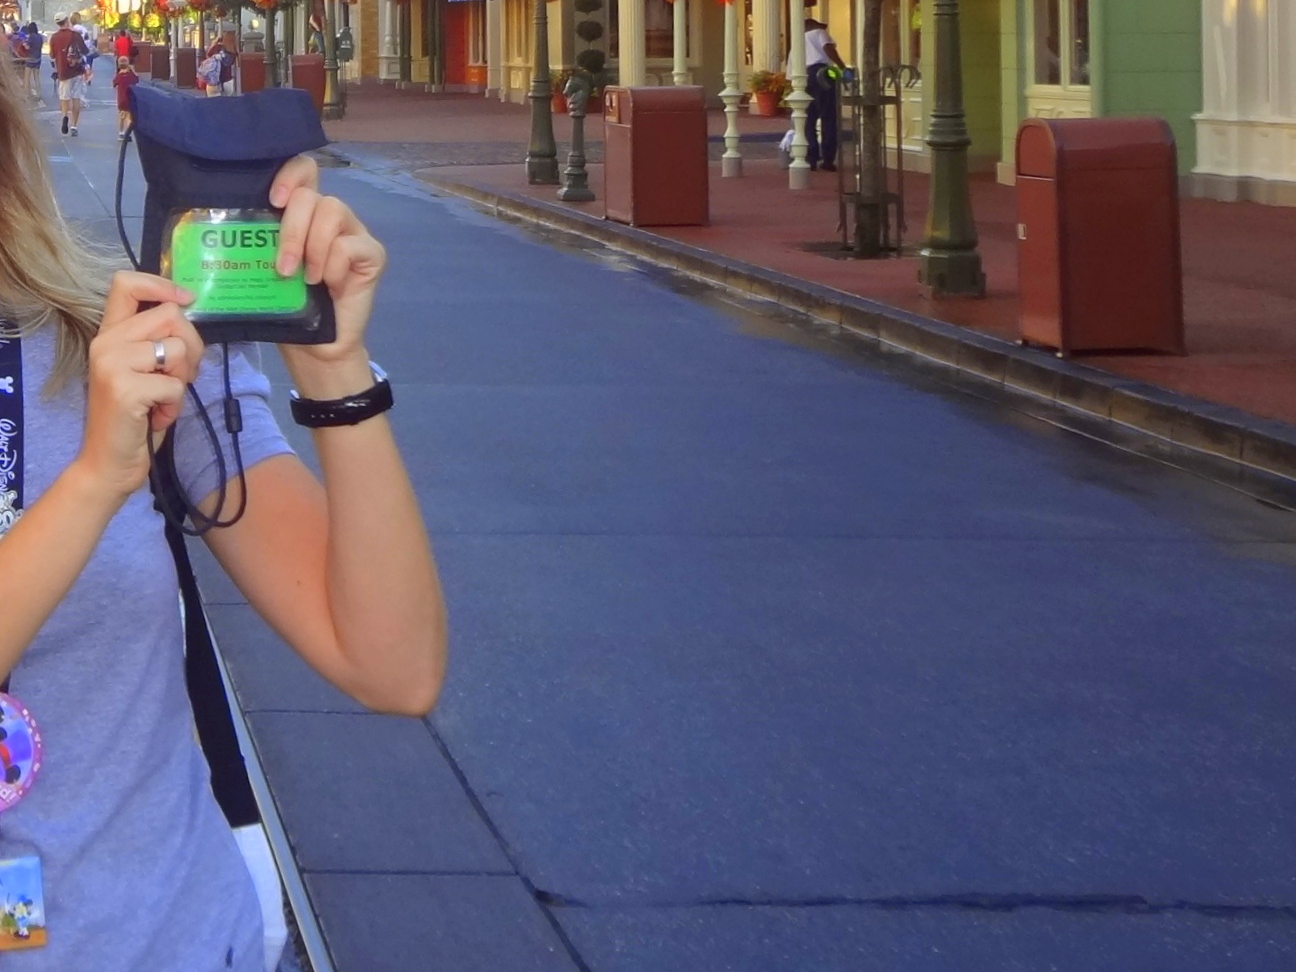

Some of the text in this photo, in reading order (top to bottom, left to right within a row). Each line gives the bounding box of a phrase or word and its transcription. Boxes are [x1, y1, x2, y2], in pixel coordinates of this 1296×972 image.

[201, 229, 280, 248] GUEST
[200, 260, 277, 270] 8:30am Tou
